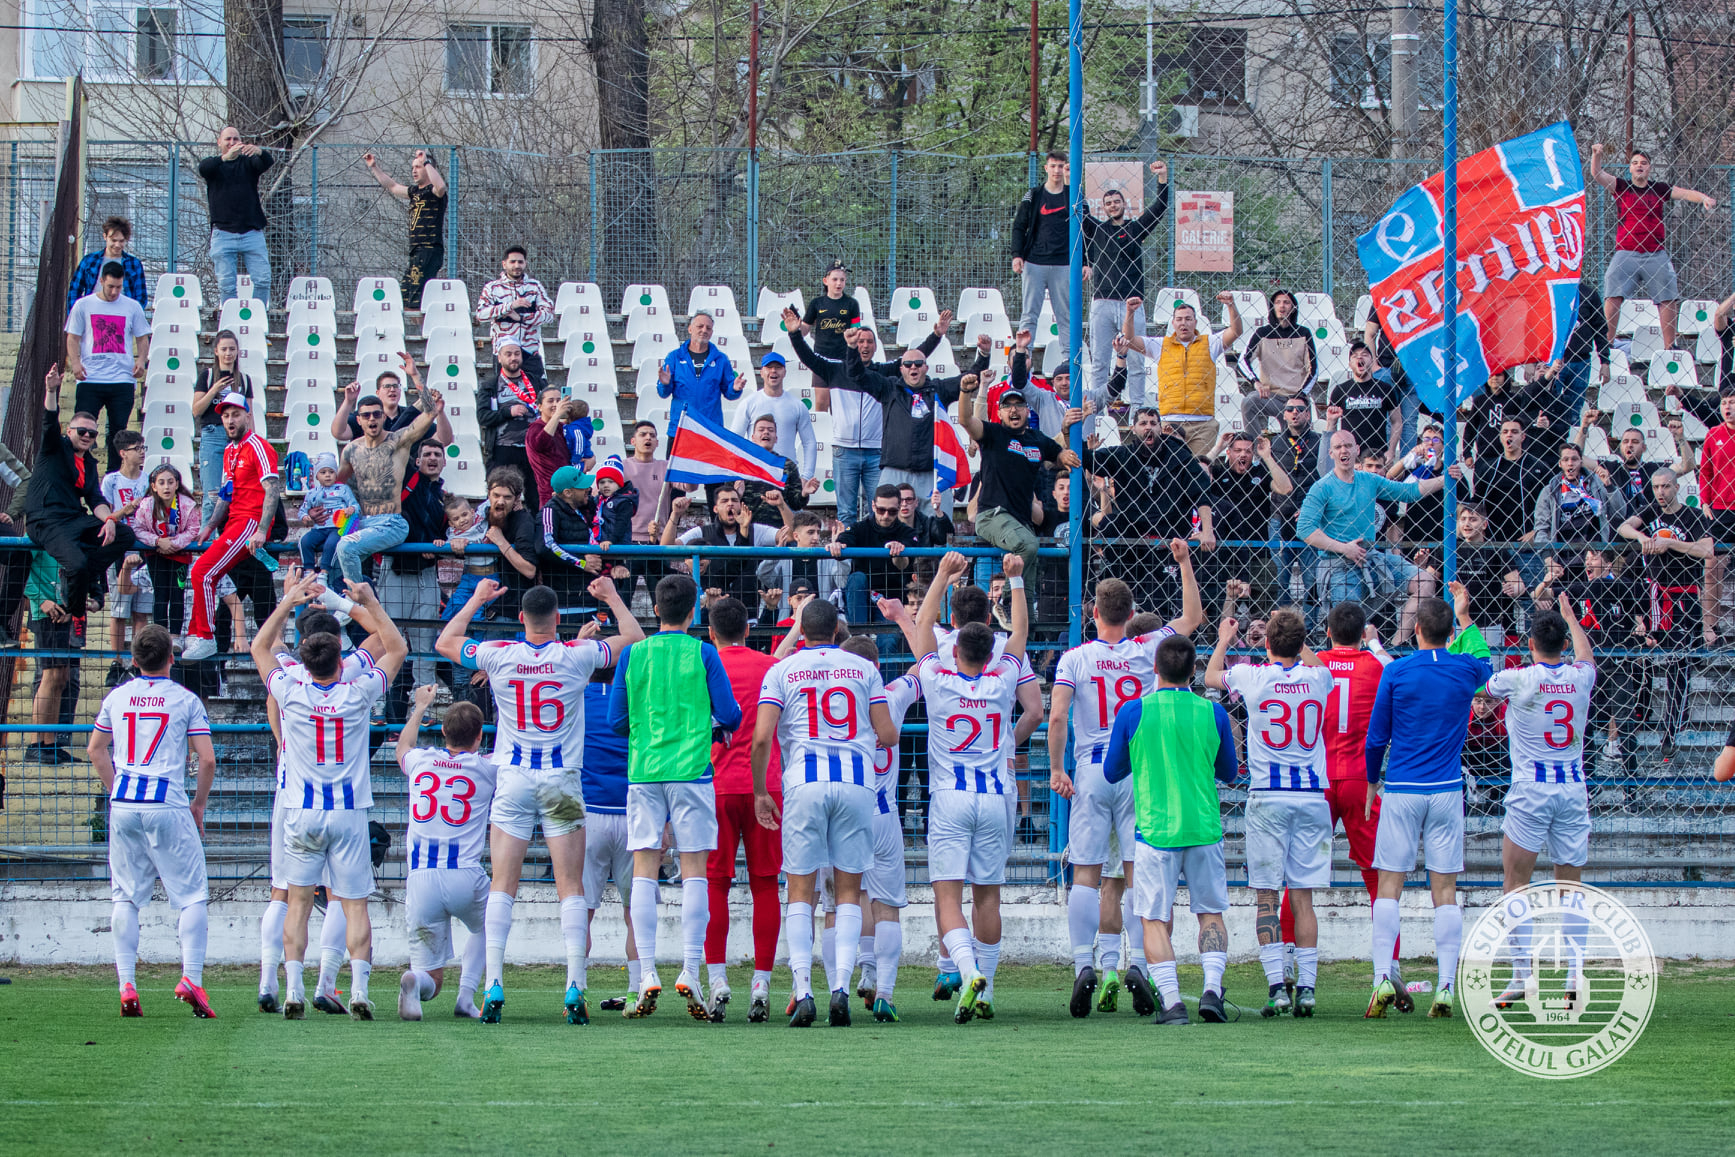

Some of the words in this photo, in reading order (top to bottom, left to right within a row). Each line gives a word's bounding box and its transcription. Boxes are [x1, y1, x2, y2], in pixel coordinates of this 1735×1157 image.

[1181, 229, 1228, 245] GALERIE
[516, 663, 556, 675] GHIOCEL
[787, 668, 864, 684] SERRANT-GREEN
[1274, 682, 1310, 694] CISOTTI
[1329, 660, 1354, 671] URSU
[1539, 683, 1576, 694] NEDELEA
[129, 696, 165, 708] NISTOR
[507, 679, 565, 733] 16
[799, 686, 858, 742] 19
[959, 697, 987, 709] SAVU
[1090, 675, 1143, 730] 18
[1259, 699, 1323, 752] 30
[1334, 677, 1350, 734] 1
[1544, 699, 1574, 751] 3
[122, 712, 170, 767] 17
[308, 714, 345, 766] 11
[945, 712, 1001, 755] 21
[412, 771, 476, 828] 33
